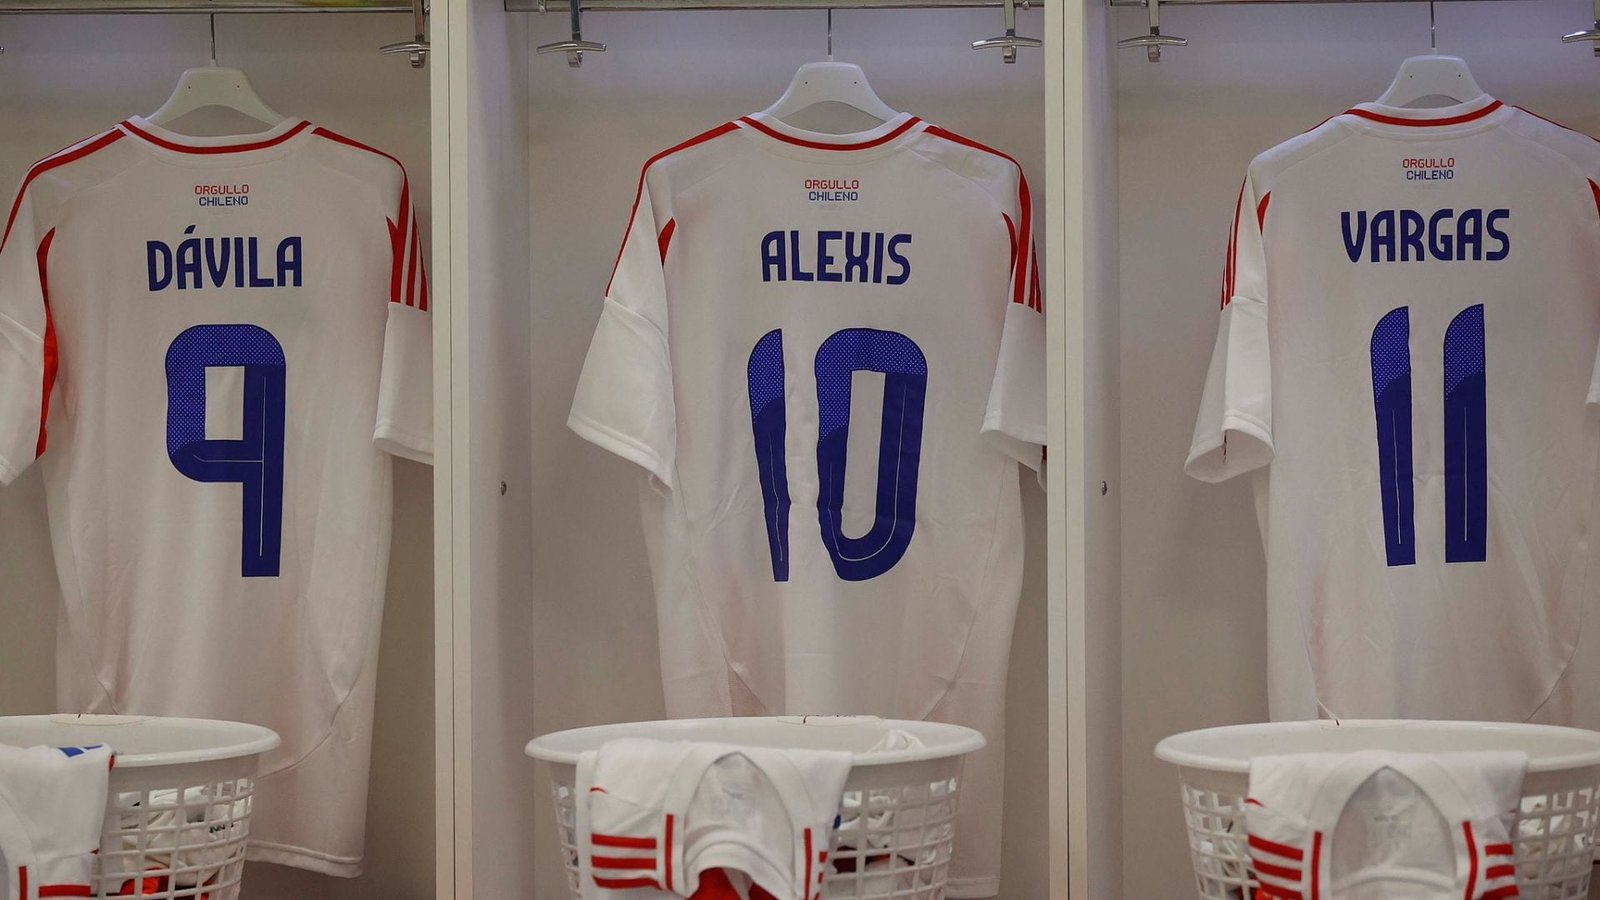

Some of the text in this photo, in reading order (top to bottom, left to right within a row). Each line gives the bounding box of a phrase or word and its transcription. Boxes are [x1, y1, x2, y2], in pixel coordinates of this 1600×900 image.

[1402, 157, 1455, 168] ORGULLO
[1406, 169, 1454, 180] CHILENO
[195, 184, 250, 195] ORGULLO
[805, 179, 859, 190] ORGULLO
[809, 191, 858, 202] CHILENO
[199, 196, 249, 207] CHILENO
[1341, 208, 1510, 263] VARGAS
[147, 225, 302, 291] DÁVILA
[761, 230, 912, 285] ALEXIS
[165, 324, 286, 577] 9
[1370, 304, 1488, 566] 11
[748, 328, 928, 582] 10
